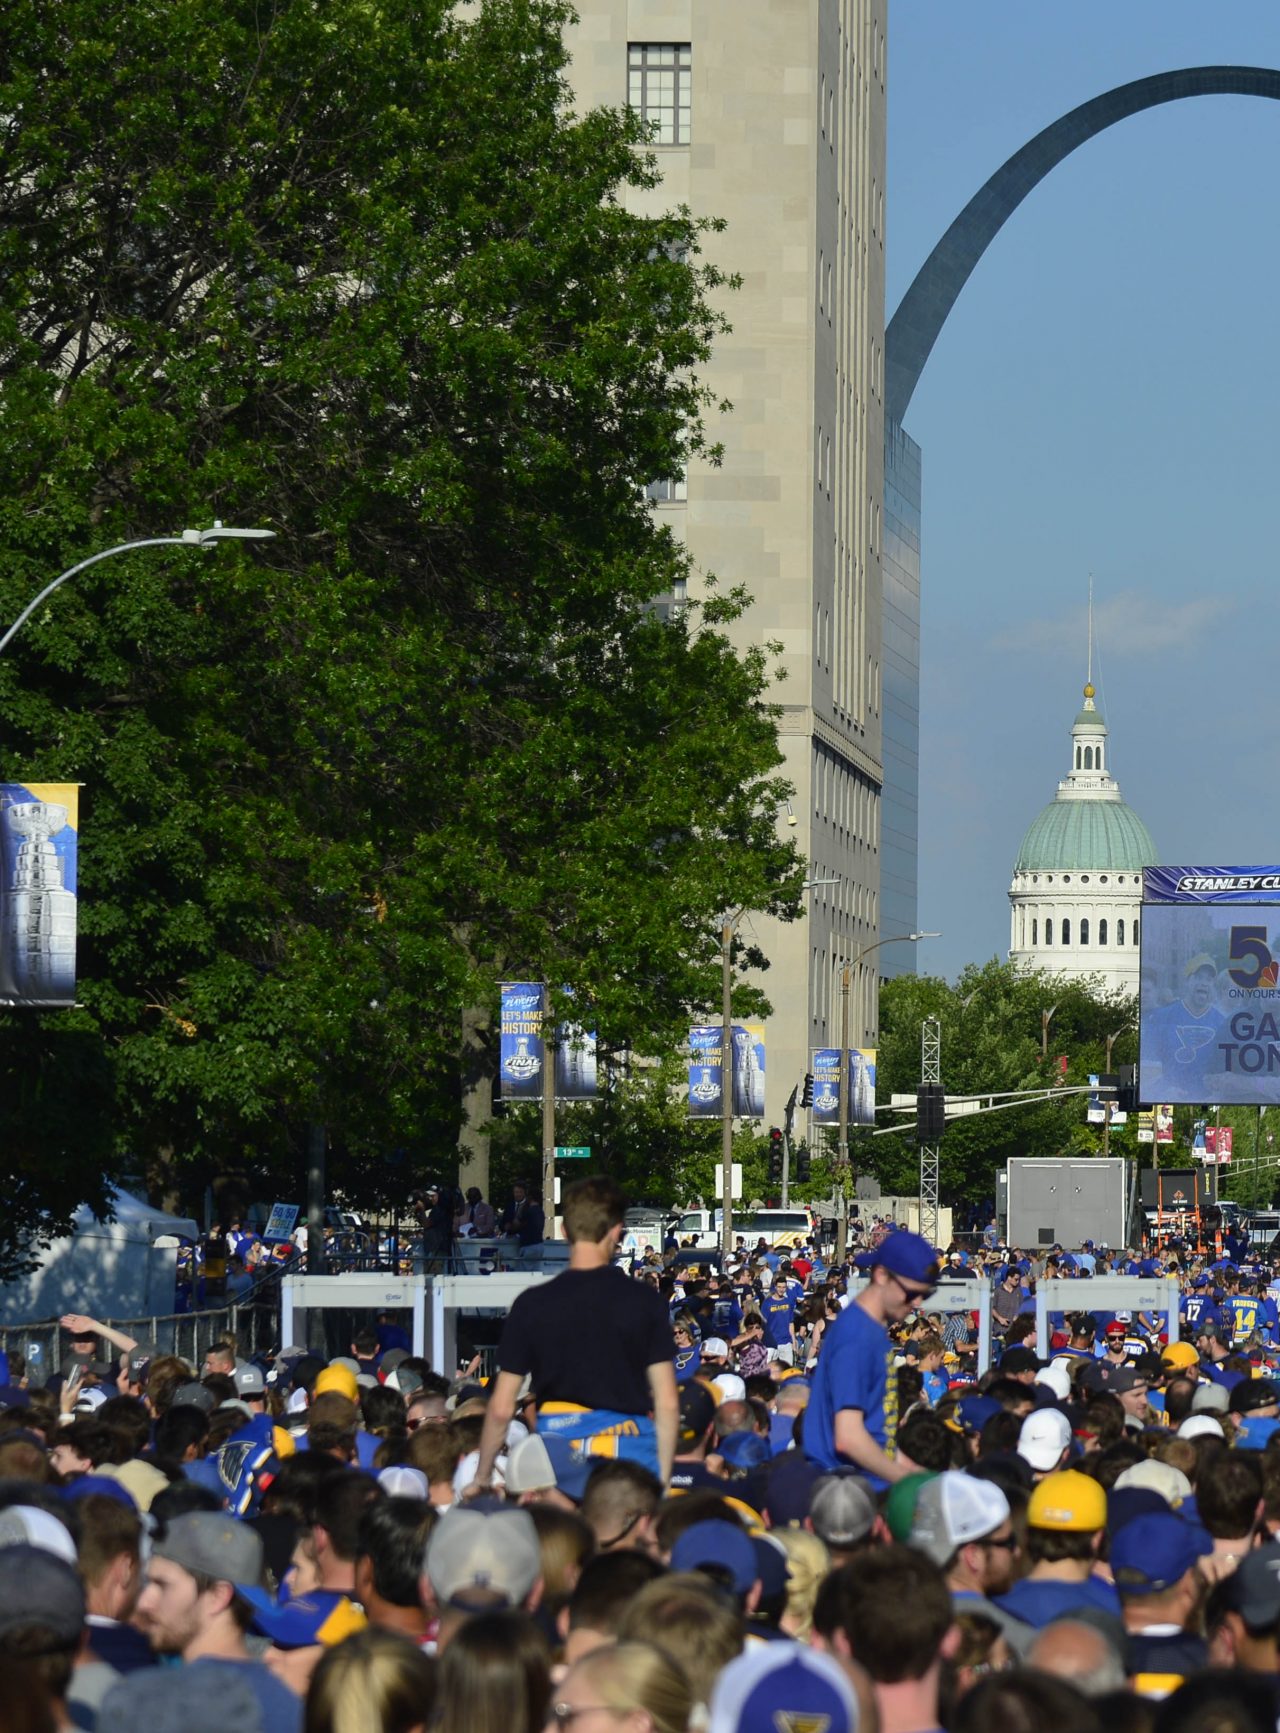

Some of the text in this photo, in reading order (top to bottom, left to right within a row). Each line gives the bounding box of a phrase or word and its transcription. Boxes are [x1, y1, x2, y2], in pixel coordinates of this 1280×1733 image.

[1181, 877, 1260, 892] STANLEY
[1229, 926, 1272, 988] 5
[1229, 989, 1244, 998] ON
[1247, 989, 1275, 998] YOUR
[506, 995, 540, 1006] PLAYOFFS
[502, 1011, 543, 1020] LET'S MAKE
[502, 1022, 542, 1034] HISTORY
[814, 1074, 840, 1083] HISTORY
[1187, 1305, 1201, 1321] 17
[1235, 1309, 1255, 1330] 14
[28, 1344, 40, 1360] P
